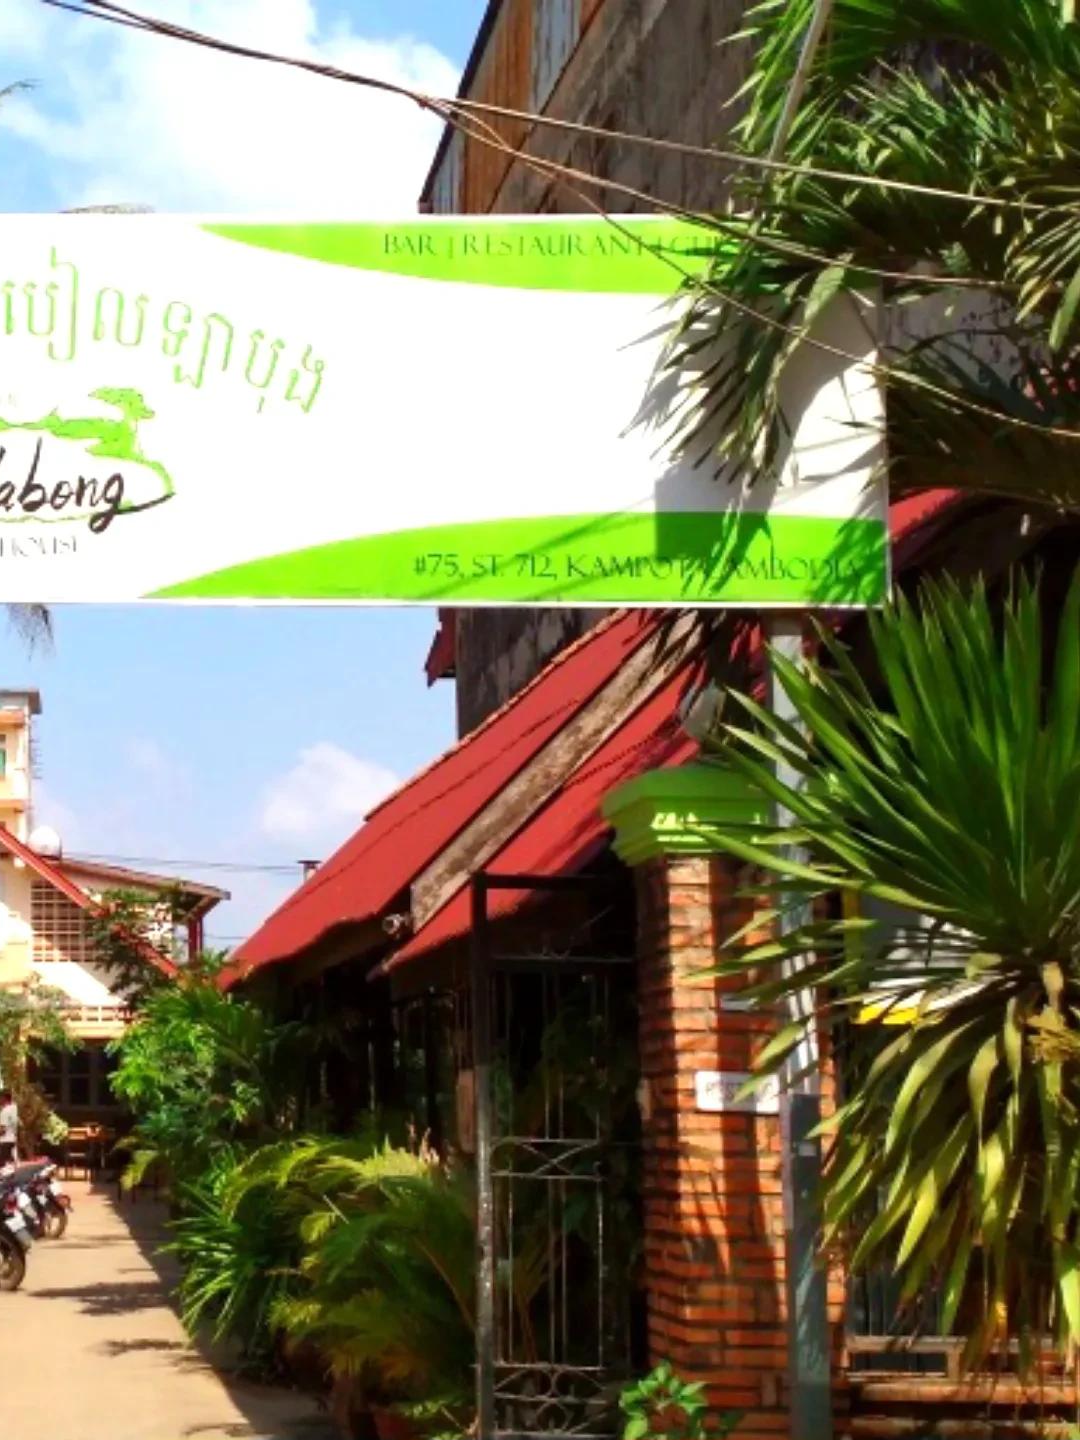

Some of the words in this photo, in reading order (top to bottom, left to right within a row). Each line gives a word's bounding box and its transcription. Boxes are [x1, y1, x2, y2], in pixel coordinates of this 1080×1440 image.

[384, 233, 436, 257] BAR
[462, 233, 644, 257] RESTAURANT
[414, 553, 465, 580] #75,
[514, 553, 558, 581] 712,
